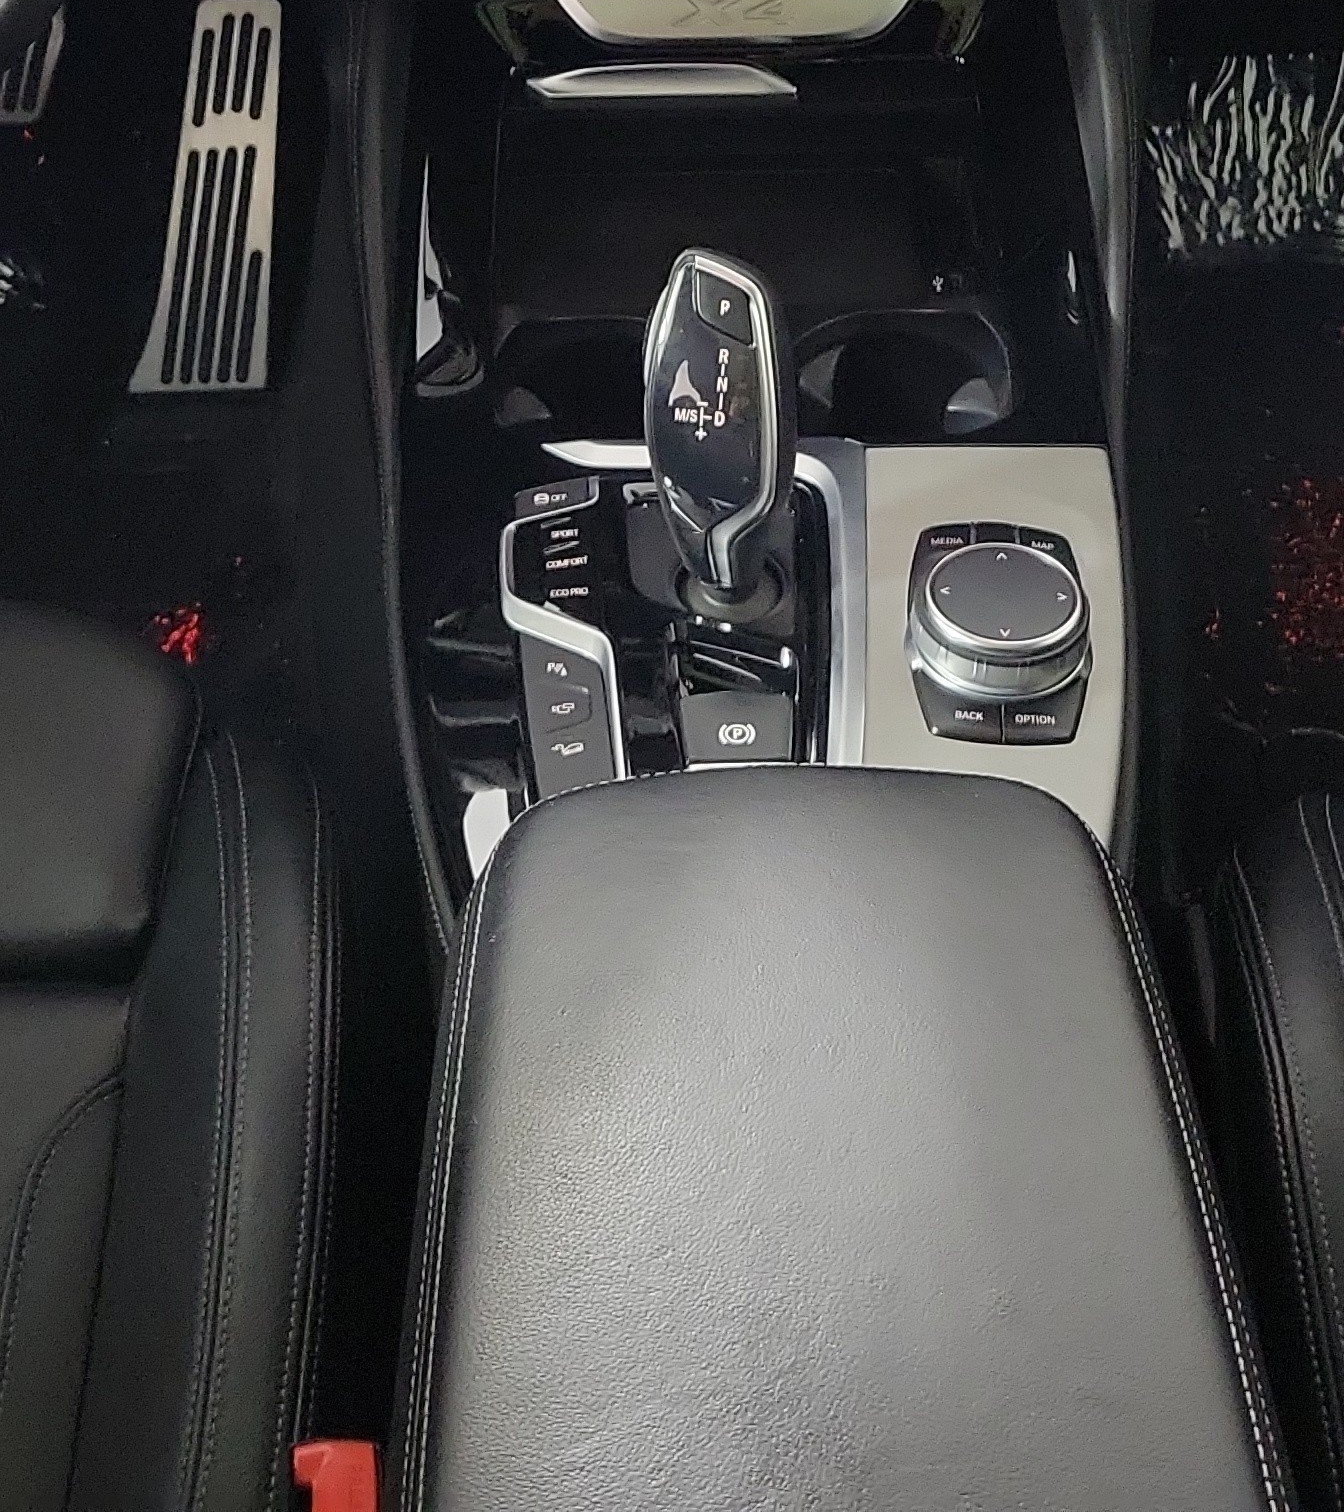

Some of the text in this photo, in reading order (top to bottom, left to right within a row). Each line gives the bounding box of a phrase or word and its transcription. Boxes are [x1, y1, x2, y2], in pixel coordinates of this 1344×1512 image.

[719, 299, 731, 316] P
[718, 348, 730, 365] R
[716, 376, 729, 393] N
[674, 407, 698, 423] M/S
[714, 410, 726, 427] D
[550, 528, 579, 539] SPORT
[930, 537, 964, 546] MEDIA
[1031, 540, 1055, 551] MAP
[545, 555, 588, 570] COMFORT
[955, 709, 984, 721] BACK
[1015, 713, 1056, 726] OPTION
